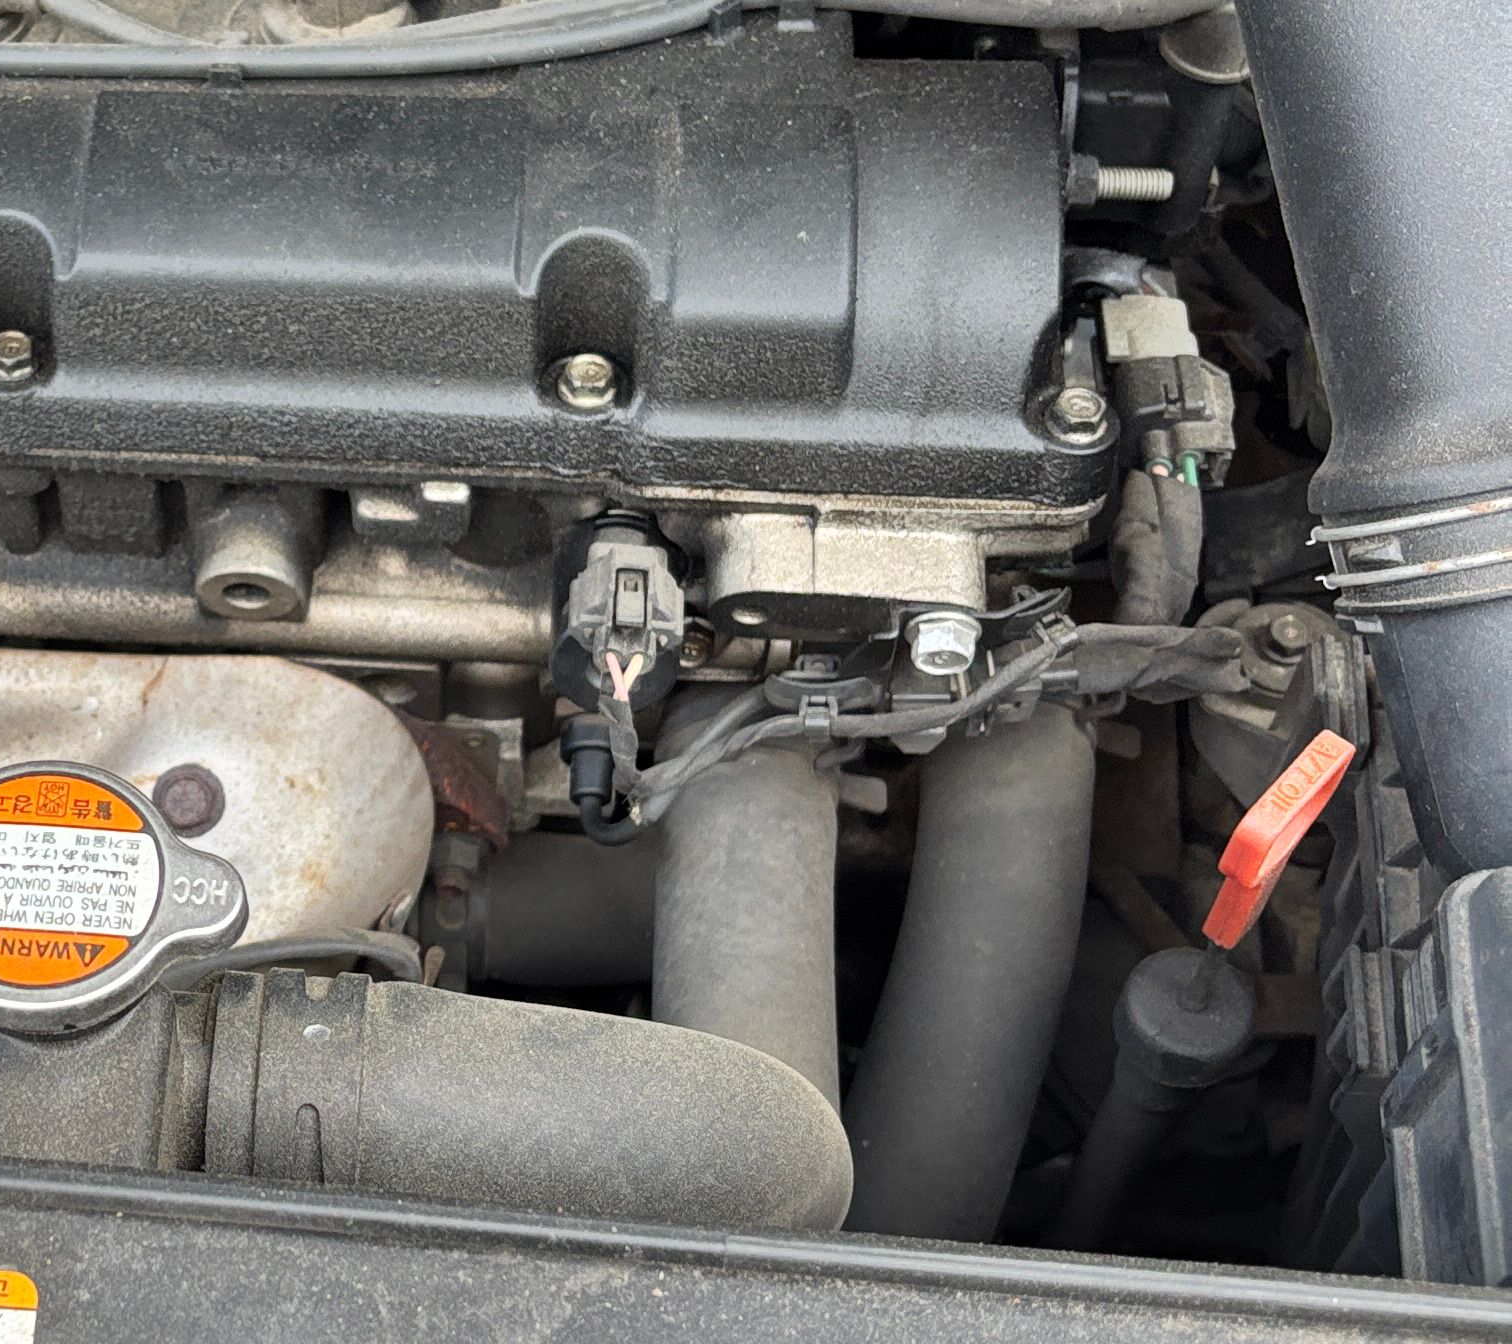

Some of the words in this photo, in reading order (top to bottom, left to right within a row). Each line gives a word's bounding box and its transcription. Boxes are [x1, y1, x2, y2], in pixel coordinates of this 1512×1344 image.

[24, 830, 56, 844] 열지
[56, 878, 103, 894] APRIRE
[108, 882, 136, 897] NON
[171, 876, 228, 905] HCC
[19, 893, 73, 908] OUVRIR
[80, 896, 107, 911] PAS
[115, 899, 134, 913] NE
[34, 910, 76, 926] OPEN
[82, 913, 133, 930] NEVER
